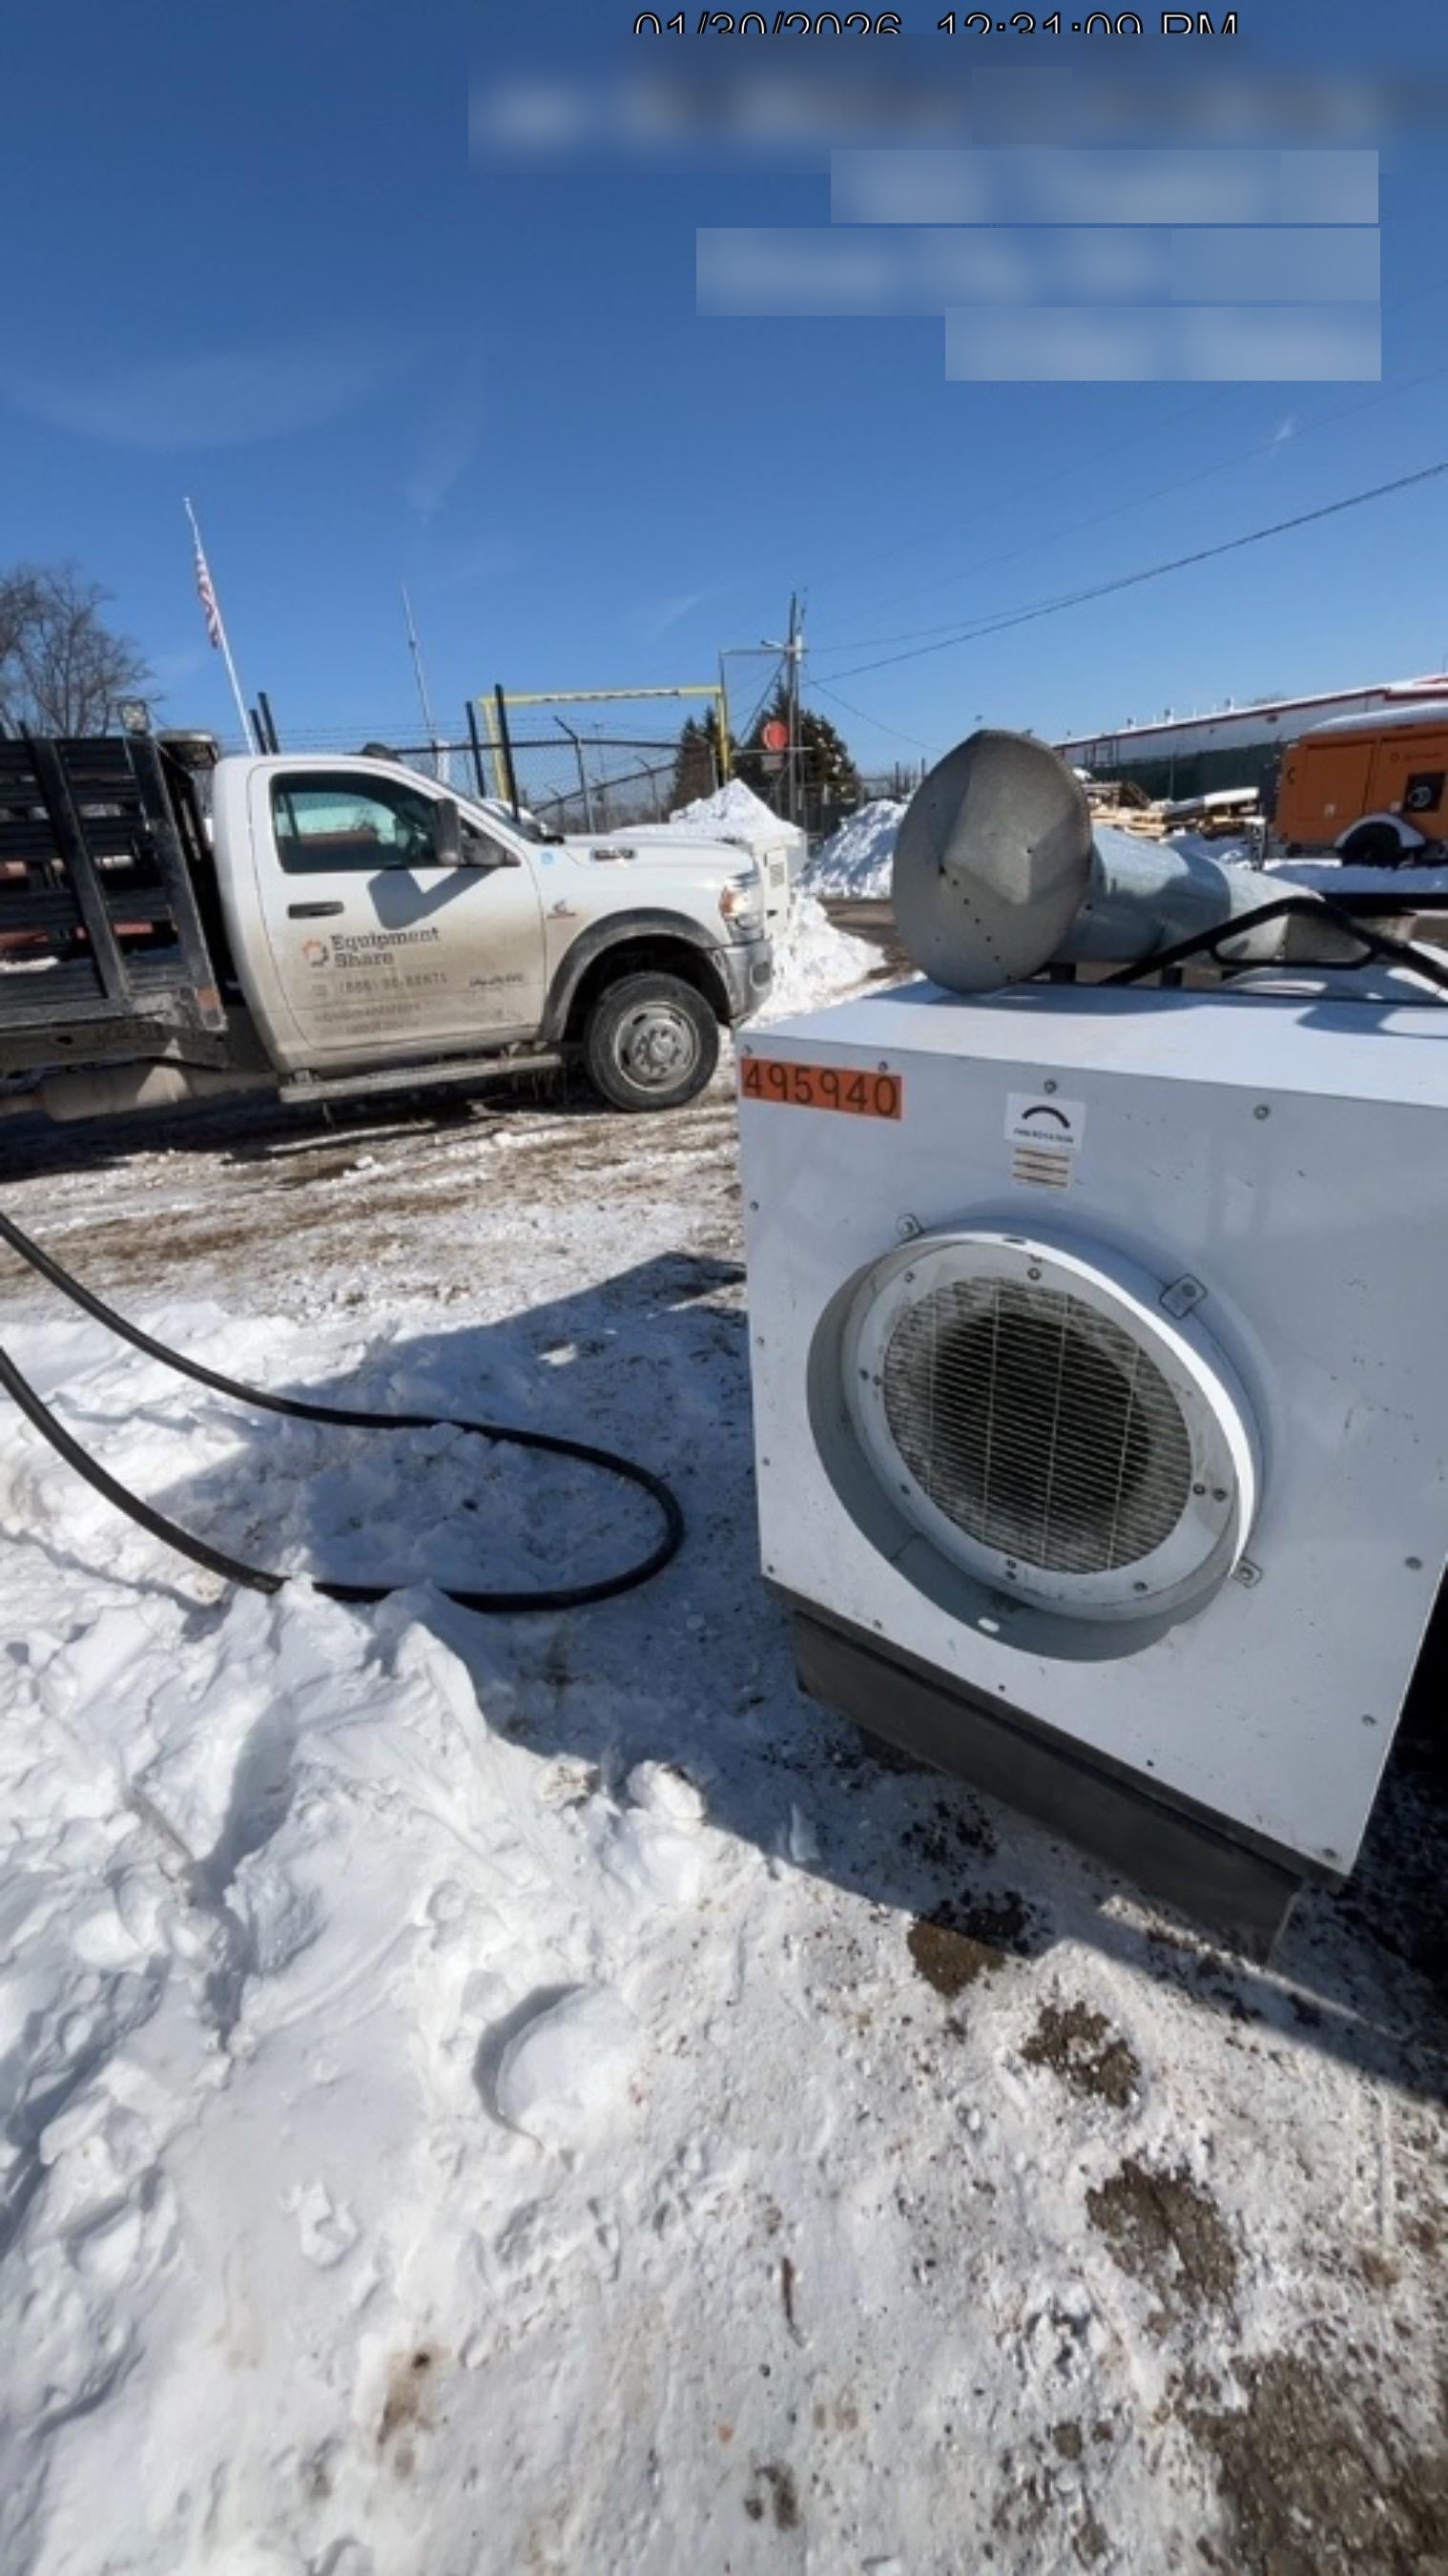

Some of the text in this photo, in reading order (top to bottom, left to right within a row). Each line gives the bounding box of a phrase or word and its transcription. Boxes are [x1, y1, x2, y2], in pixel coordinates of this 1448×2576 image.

[330, 927, 439, 951] Equipment
[334, 952, 395, 968] Share
[743, 1061, 898, 1117] 495940
